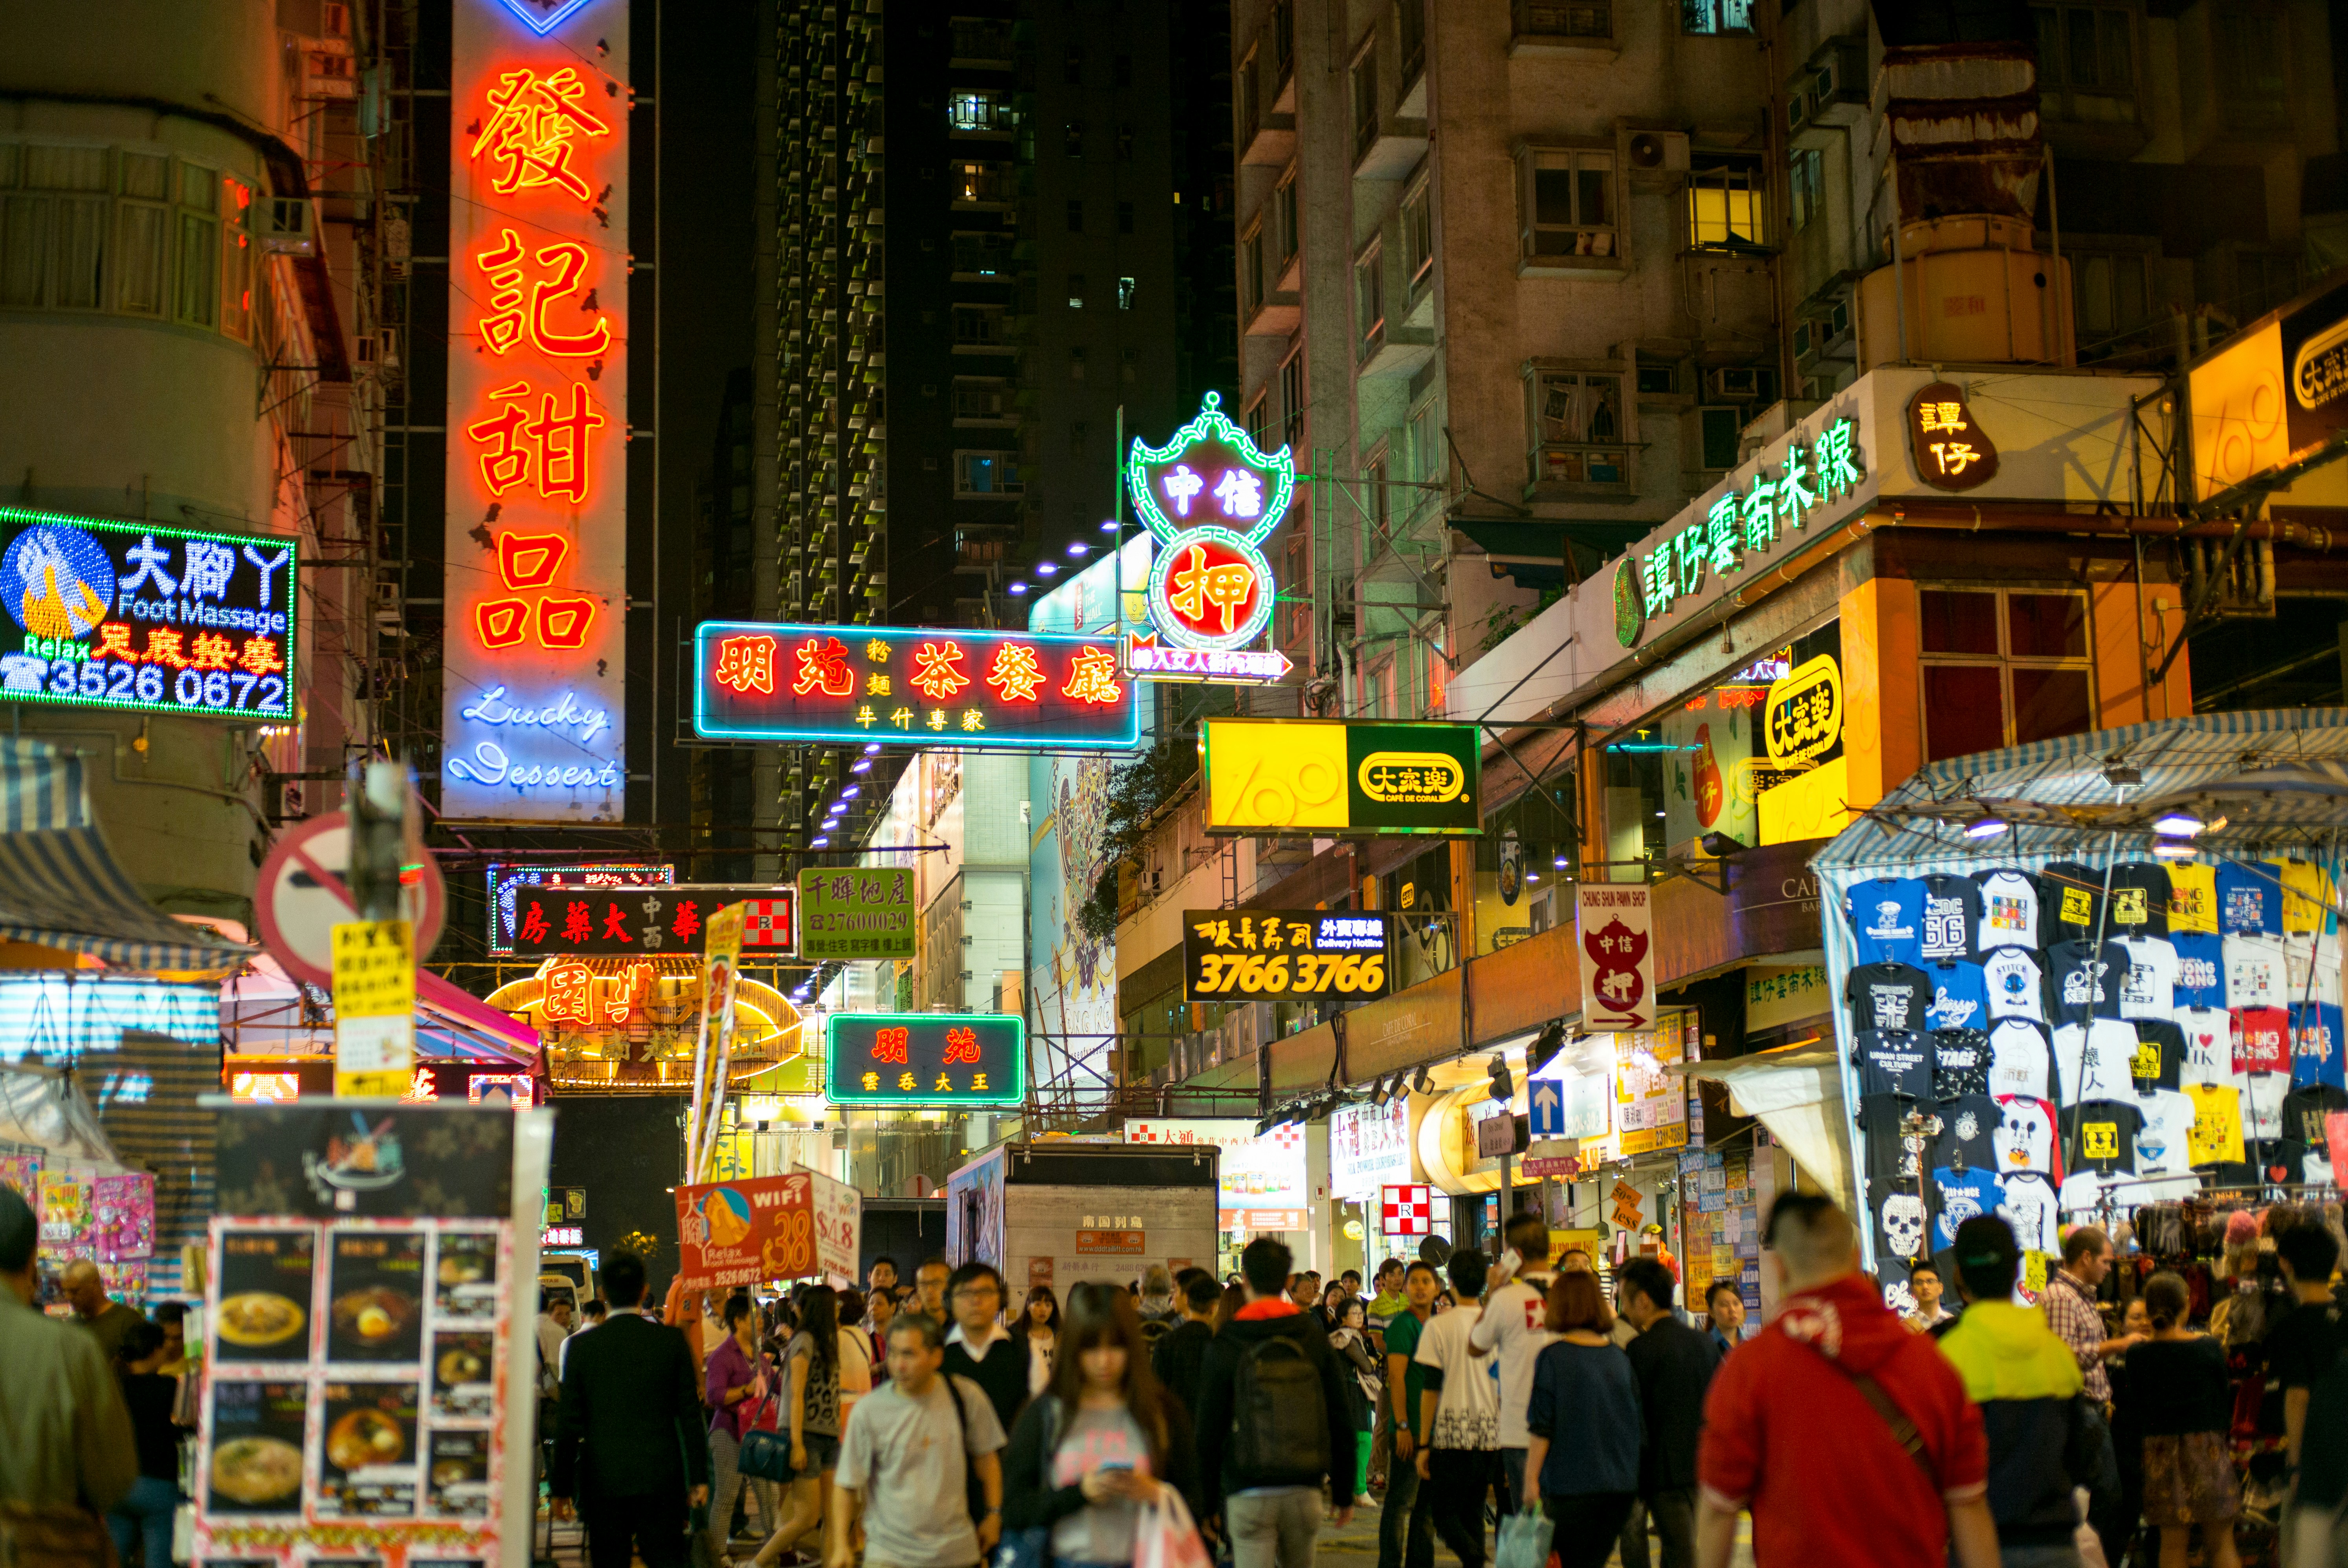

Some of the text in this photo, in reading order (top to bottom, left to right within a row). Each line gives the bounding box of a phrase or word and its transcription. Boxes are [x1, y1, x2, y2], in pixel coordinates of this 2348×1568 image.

[467, 66, 612, 648] 發記甜品
[1920, 401, 1981, 475] 譚仔
[1163, 465, 1262, 517] 中信
[1643, 417, 1858, 620] 譚仔雲南米線
[118, 533, 290, 608] 大腳丫
[1170, 544, 1255, 633] 押
[118, 592, 286, 637] Foot Massage
[24, 633, 90, 663] Relax
[90, 621, 284, 677] 足底按摩
[715, 635, 1122, 704] 明苑 茶餐廳
[866, 637, 892, 696] 粉麵
[50, 659, 285, 713] 3526 0672
[464, 685, 608, 742] Lucky
[855, 705, 986, 731] 牛什專家
[448, 741, 618, 788] Dessert
[805, 873, 910, 907] 千暉地產
[1583, 891, 1646, 907] CHUNG SHUN PAWN SHOP
[827, 911, 907, 931] 27600029
[1317, 938, 1383, 949] Delivery Hotline
[1599, 935, 1633, 954] 中信
[1194, 954, 1384, 993] 3766 3766
[1602, 968, 1635, 1003] 押
[1996, 963, 2027, 975] STITCH
[1094, 1001, 1115, 1034] KO
[871, 1027, 981, 1064] 明苑
[1869, 1051, 1924, 1062] URBAN STREET
[862, 1072, 989, 1092] 雲吞大王
[1878, 1060, 1913, 1070] CULTURE
[1542, 1166, 1573, 1174] ARTICLES
[1611, 1187, 1636, 1209] 50%
[1613, 1206, 1638, 1229] less
[761, 1209, 811, 1278] $38
